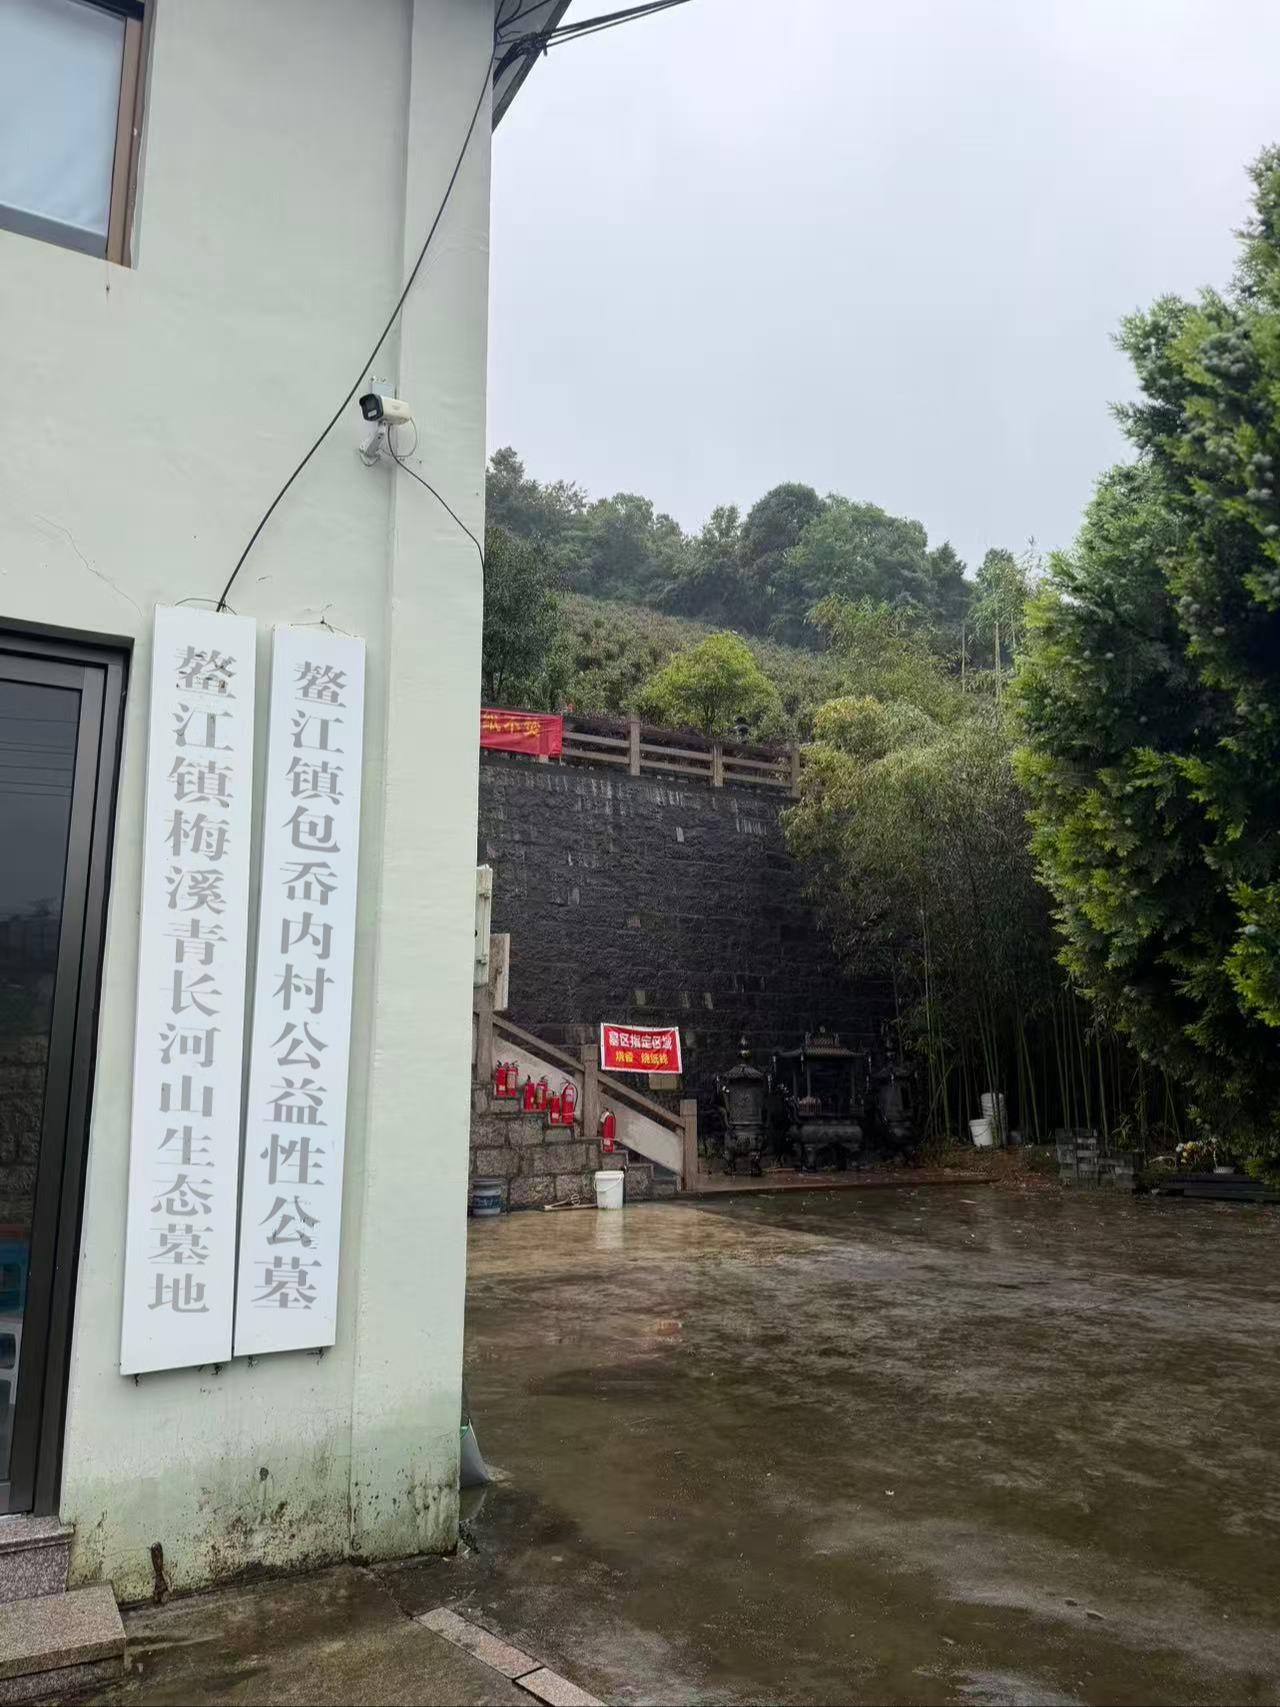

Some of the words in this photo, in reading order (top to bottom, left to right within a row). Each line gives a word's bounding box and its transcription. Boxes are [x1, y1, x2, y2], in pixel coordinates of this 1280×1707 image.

[147, 645, 238, 1313] 鳌江镇梅溪青长河山生态墓地
[251, 660, 347, 1310] 鳌江镇包岙内村公益性公墓
